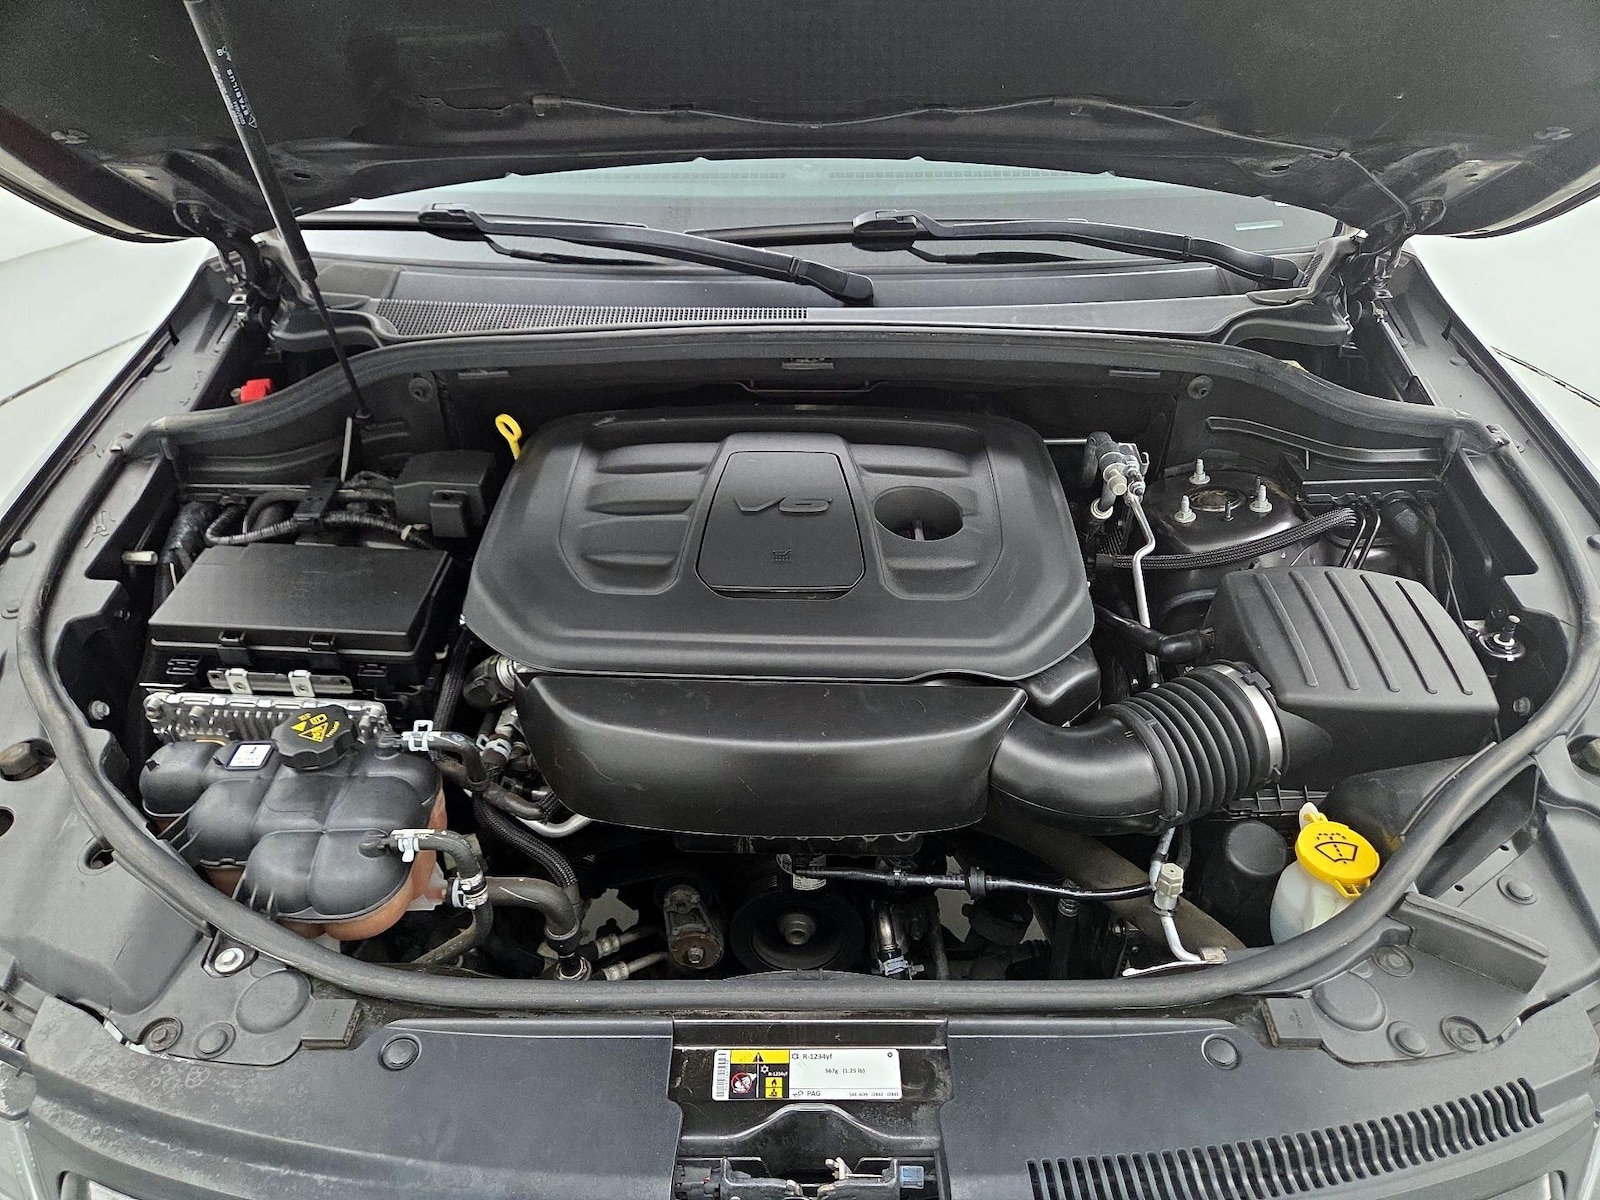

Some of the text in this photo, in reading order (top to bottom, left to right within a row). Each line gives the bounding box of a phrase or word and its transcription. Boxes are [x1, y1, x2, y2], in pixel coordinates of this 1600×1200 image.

[226, 68, 249, 116] STABILUS
[733, 496, 833, 514] V6
[802, 1052, 833, 1061] R-1234yf
[825, 1067, 839, 1075] 567g
[842, 1067, 857, 1075] (1.25
